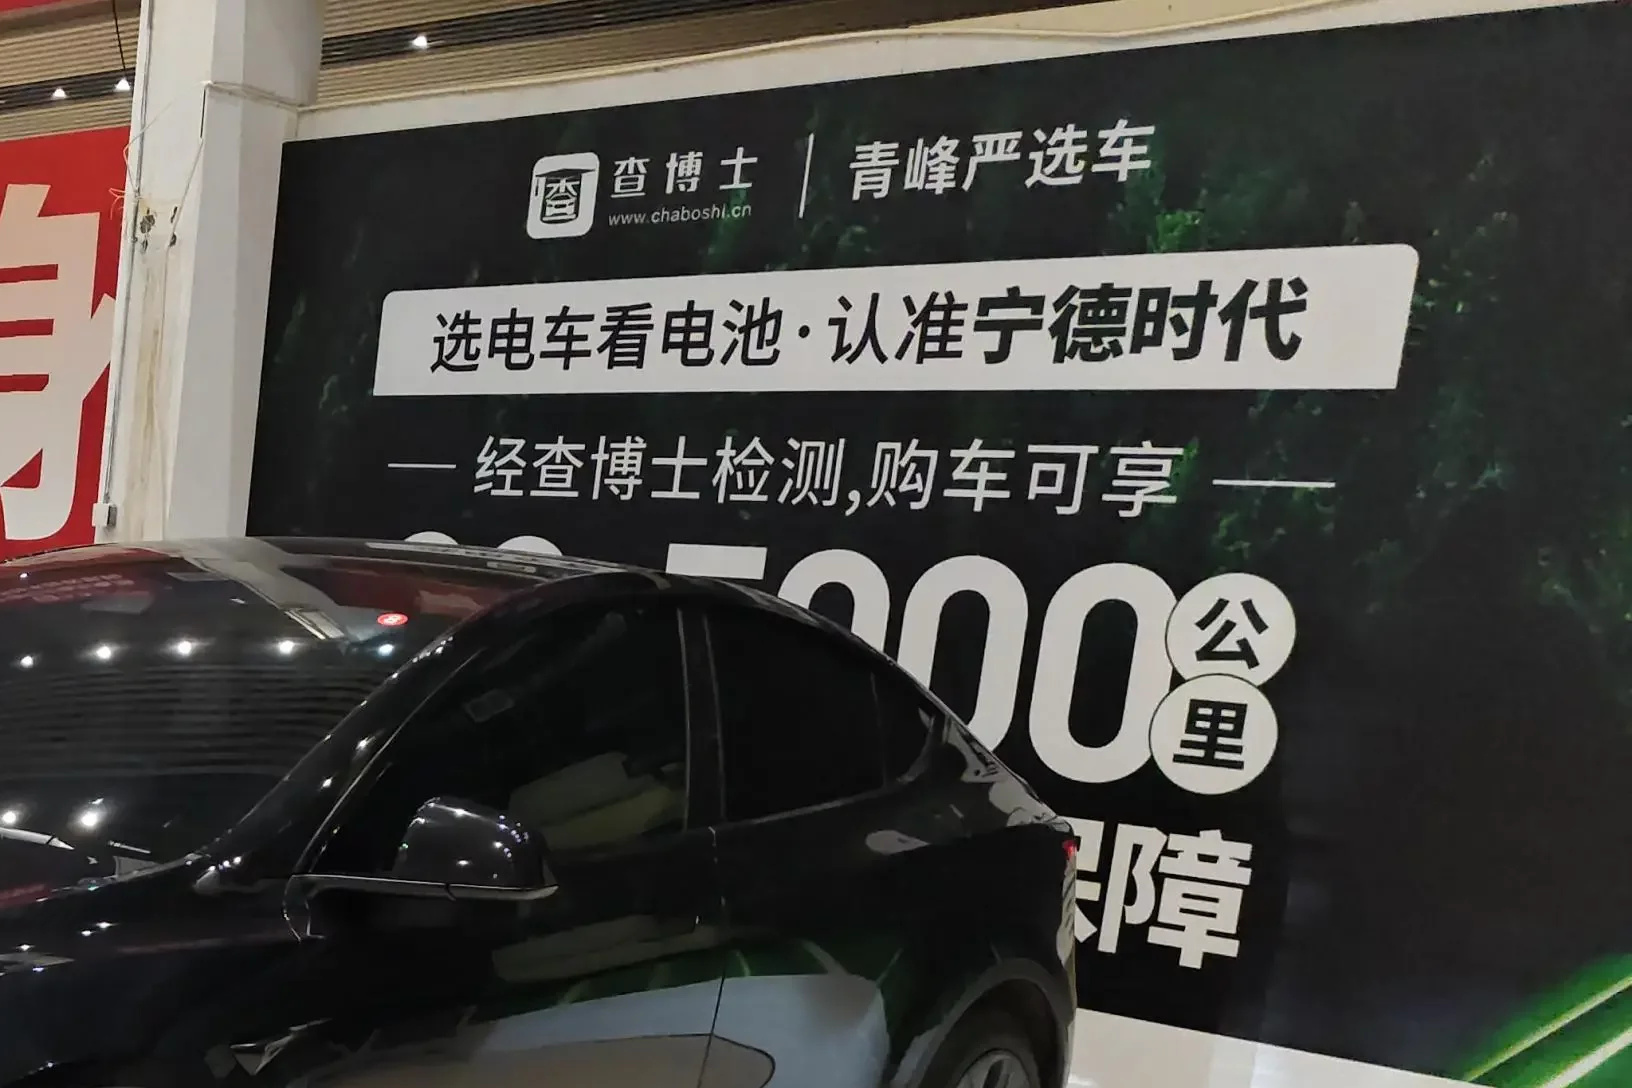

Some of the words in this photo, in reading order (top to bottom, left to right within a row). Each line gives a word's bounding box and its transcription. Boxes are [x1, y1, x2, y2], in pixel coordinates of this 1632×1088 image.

[610, 147, 759, 199] 查博士
[848, 119, 1156, 201] 青峰严选车
[608, 204, 753, 226] www.chaboshi.cn
[429, 276, 1309, 375] 选电车看电池·认准宁德时代
[473, 433, 1185, 521] 经查博士检测,购车可享
